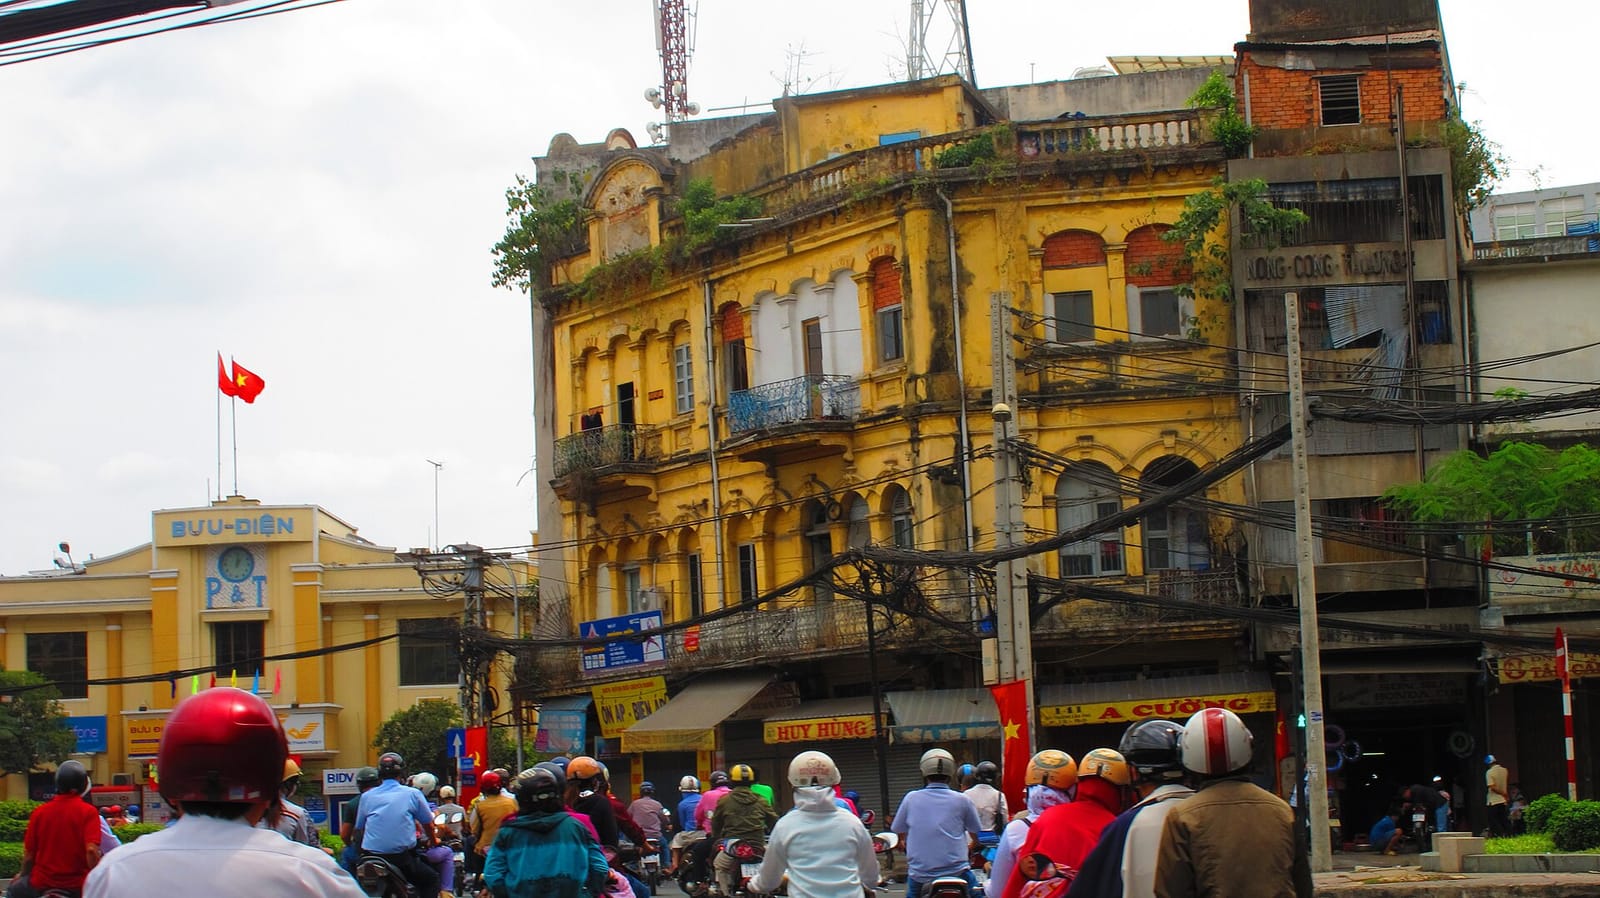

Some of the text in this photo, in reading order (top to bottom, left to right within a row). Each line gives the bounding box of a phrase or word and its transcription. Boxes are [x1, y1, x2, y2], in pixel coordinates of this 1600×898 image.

[206, 575, 268, 609] P & T
[1099, 706, 1123, 719] A
[777, 724, 812, 741] HUY
[816, 719, 867, 738] HÙNG
[327, 772, 355, 784] BIDV
